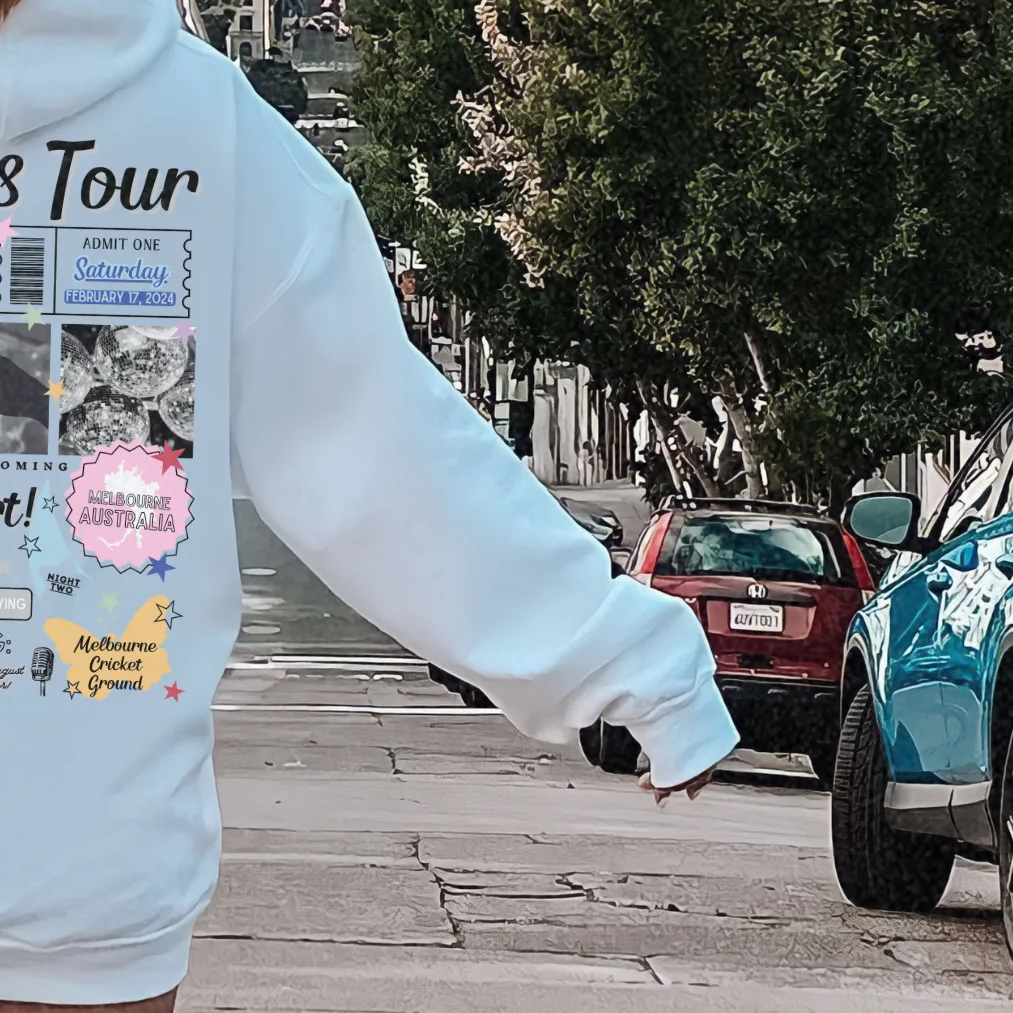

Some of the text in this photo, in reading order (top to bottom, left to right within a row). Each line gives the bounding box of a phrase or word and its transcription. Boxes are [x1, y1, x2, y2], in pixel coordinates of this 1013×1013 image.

[46, 140, 199, 221] Tour
[82, 237, 161, 251] ADMIT ONE
[65, 289, 175, 306] FEBRUARY 17, 2024
[87, 489, 172, 511] MELBOURNE
[78, 506, 176, 533] AUSTRALIA
[47, 572, 81, 587] NIGHT
[50, 583, 74, 595] TWO
[73, 635, 158, 653] Melbourne
[89, 655, 143, 672] Cricket
[88, 675, 144, 697] Ground
